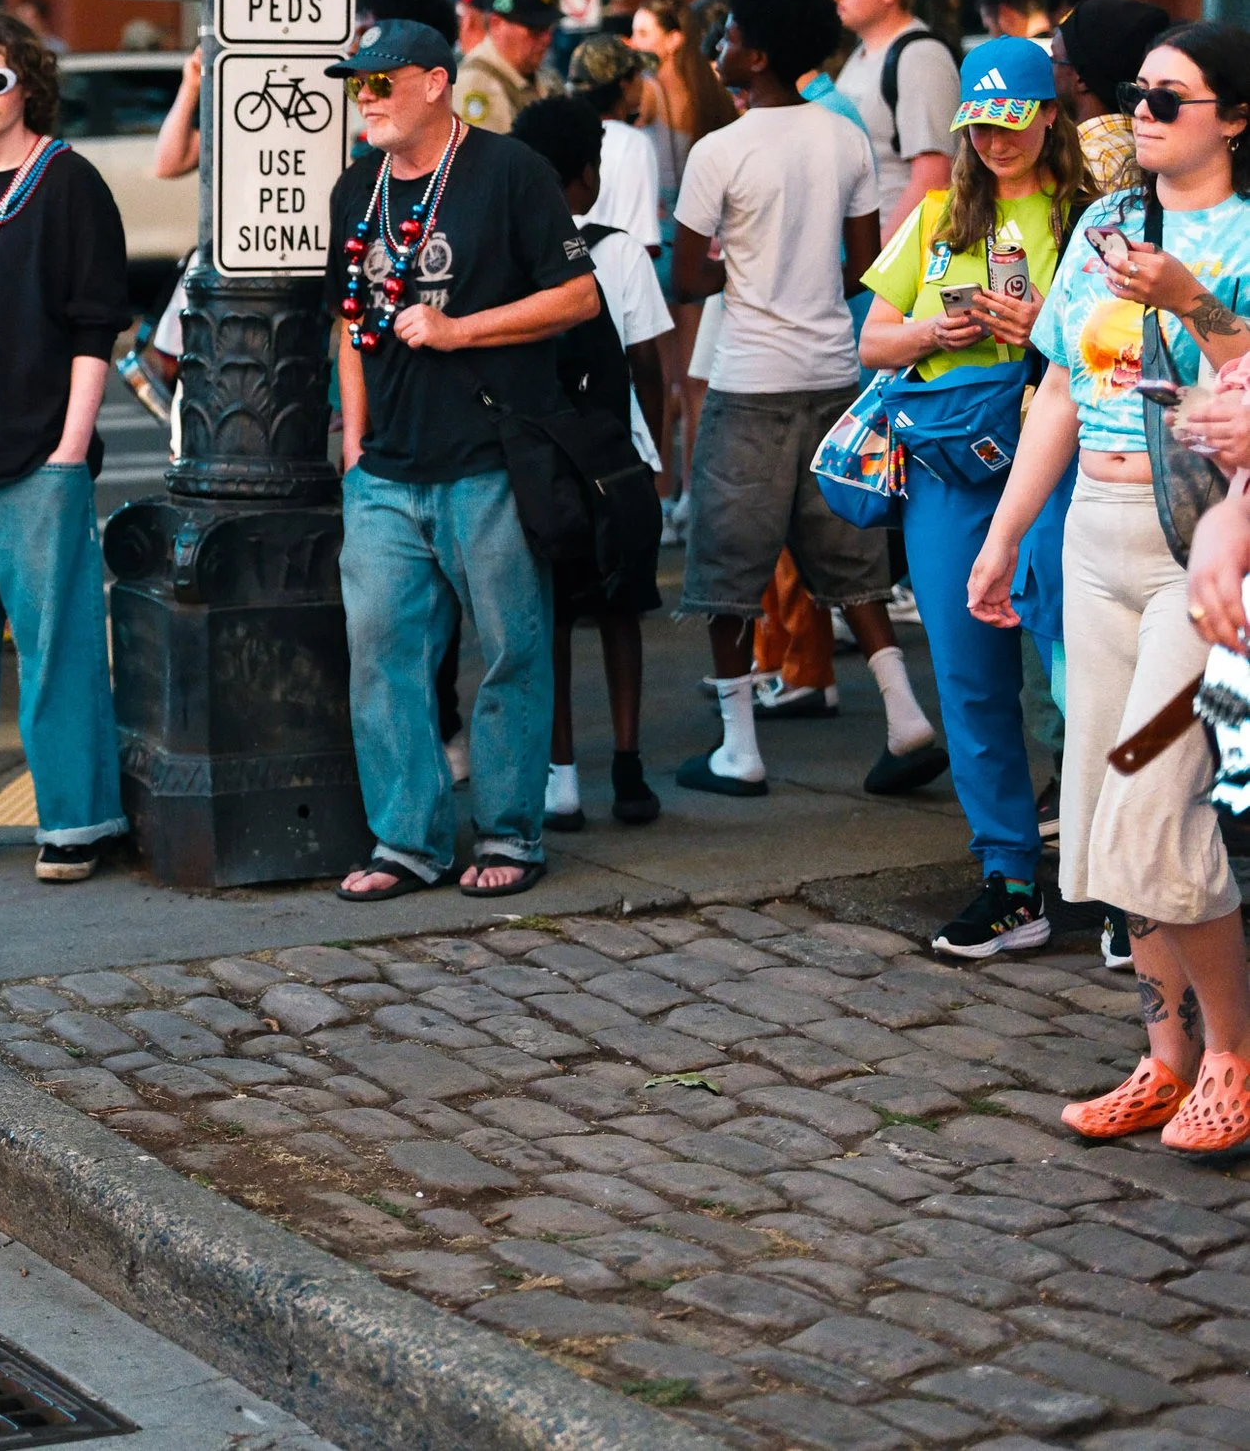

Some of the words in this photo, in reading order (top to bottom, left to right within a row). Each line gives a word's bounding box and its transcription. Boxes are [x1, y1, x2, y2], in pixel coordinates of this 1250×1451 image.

[259, 149, 306, 176] USE
[259, 187, 305, 214] PED
[238, 225, 327, 252] SIGNAL
